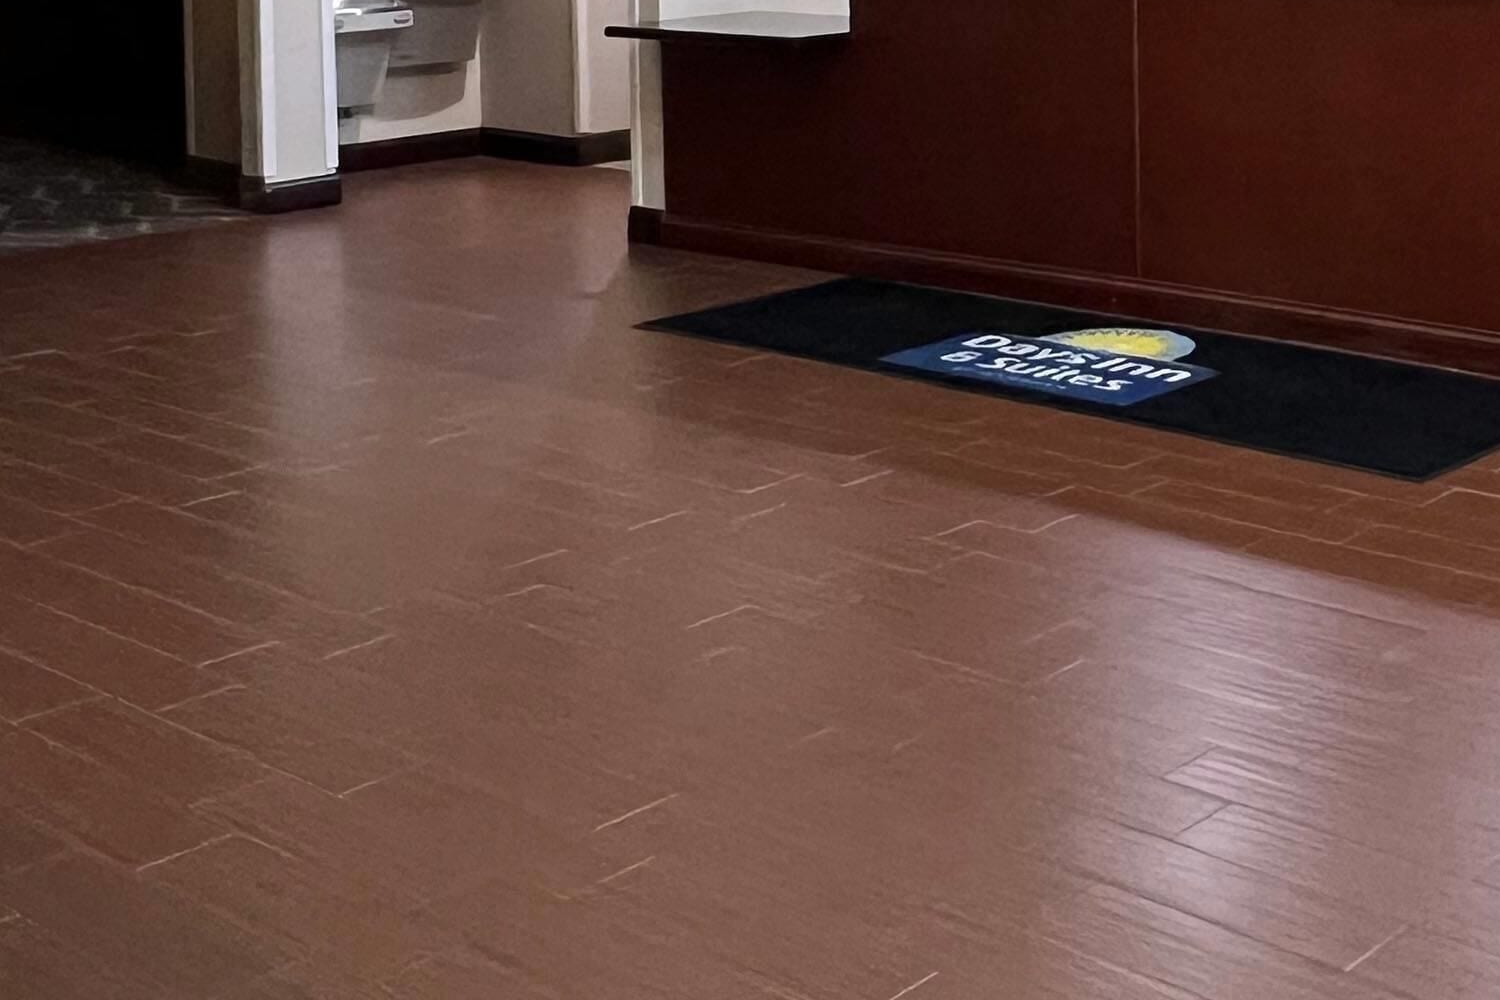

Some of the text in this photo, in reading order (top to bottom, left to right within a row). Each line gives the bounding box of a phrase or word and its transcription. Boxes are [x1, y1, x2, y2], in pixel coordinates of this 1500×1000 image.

[961, 335, 1101, 364] Days
[1090, 357, 1192, 383] Inn
[975, 357, 1134, 391] Suites
